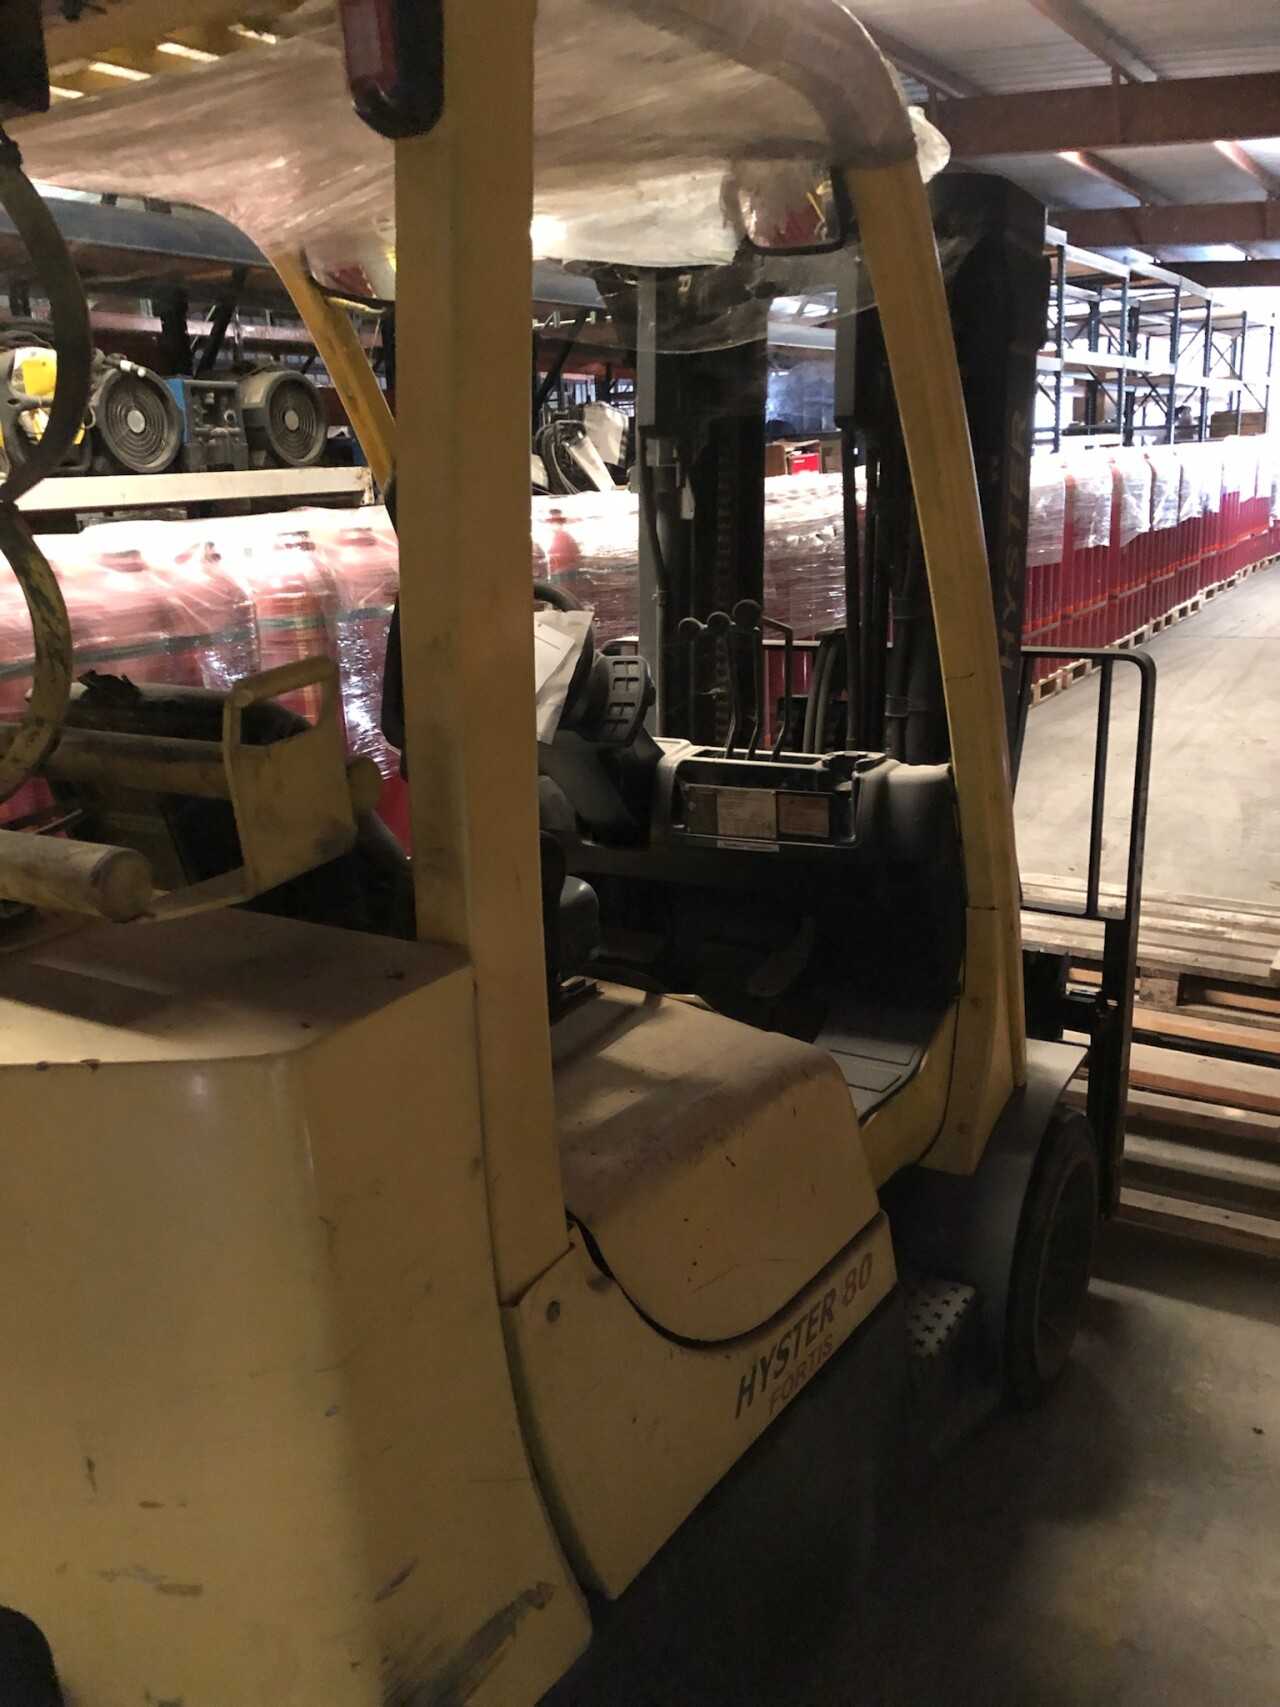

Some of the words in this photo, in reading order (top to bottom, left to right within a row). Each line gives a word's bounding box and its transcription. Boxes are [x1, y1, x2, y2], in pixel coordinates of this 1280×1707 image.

[736, 1287, 836, 1418] HYSTER
[843, 1252, 873, 1307] 80
[768, 1334, 833, 1415] FORTIS
